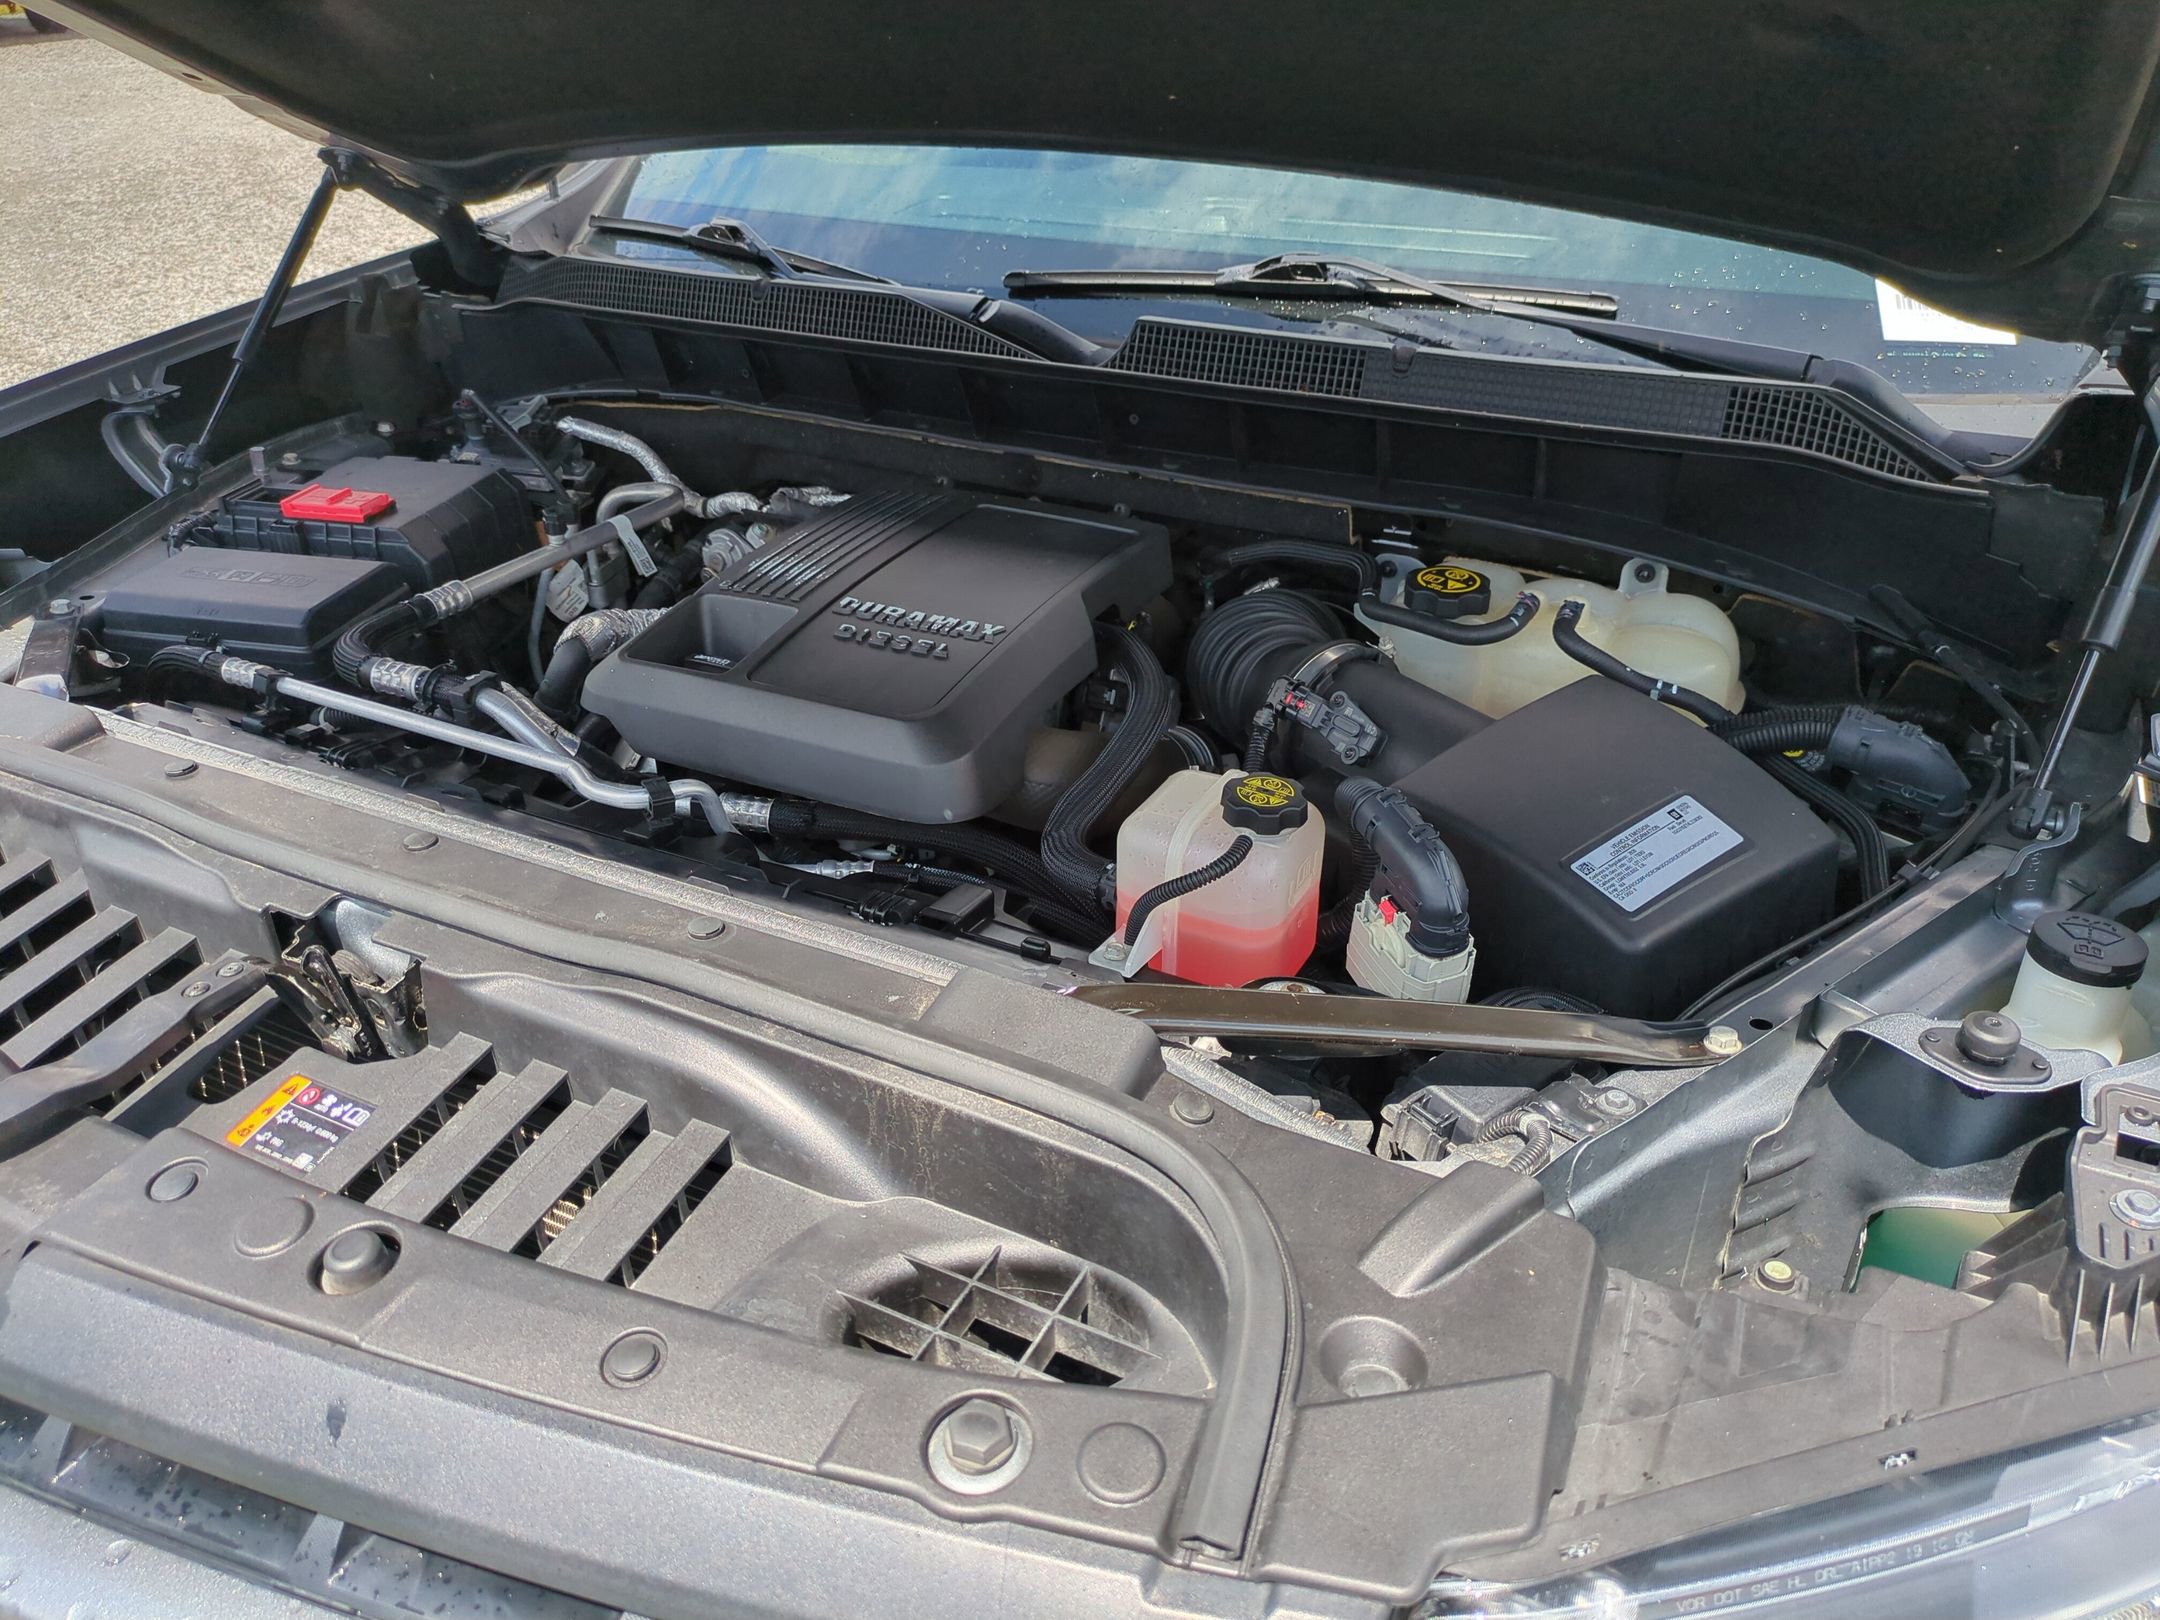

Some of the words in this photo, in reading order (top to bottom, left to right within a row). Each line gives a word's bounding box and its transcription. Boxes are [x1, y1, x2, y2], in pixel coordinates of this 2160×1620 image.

[832, 596, 1006, 644] DURAMAX
[833, 623, 949, 660] DIESEL
[1713, 1588, 1743, 1604] DOT
[1751, 1580, 1780, 1597] SAE
